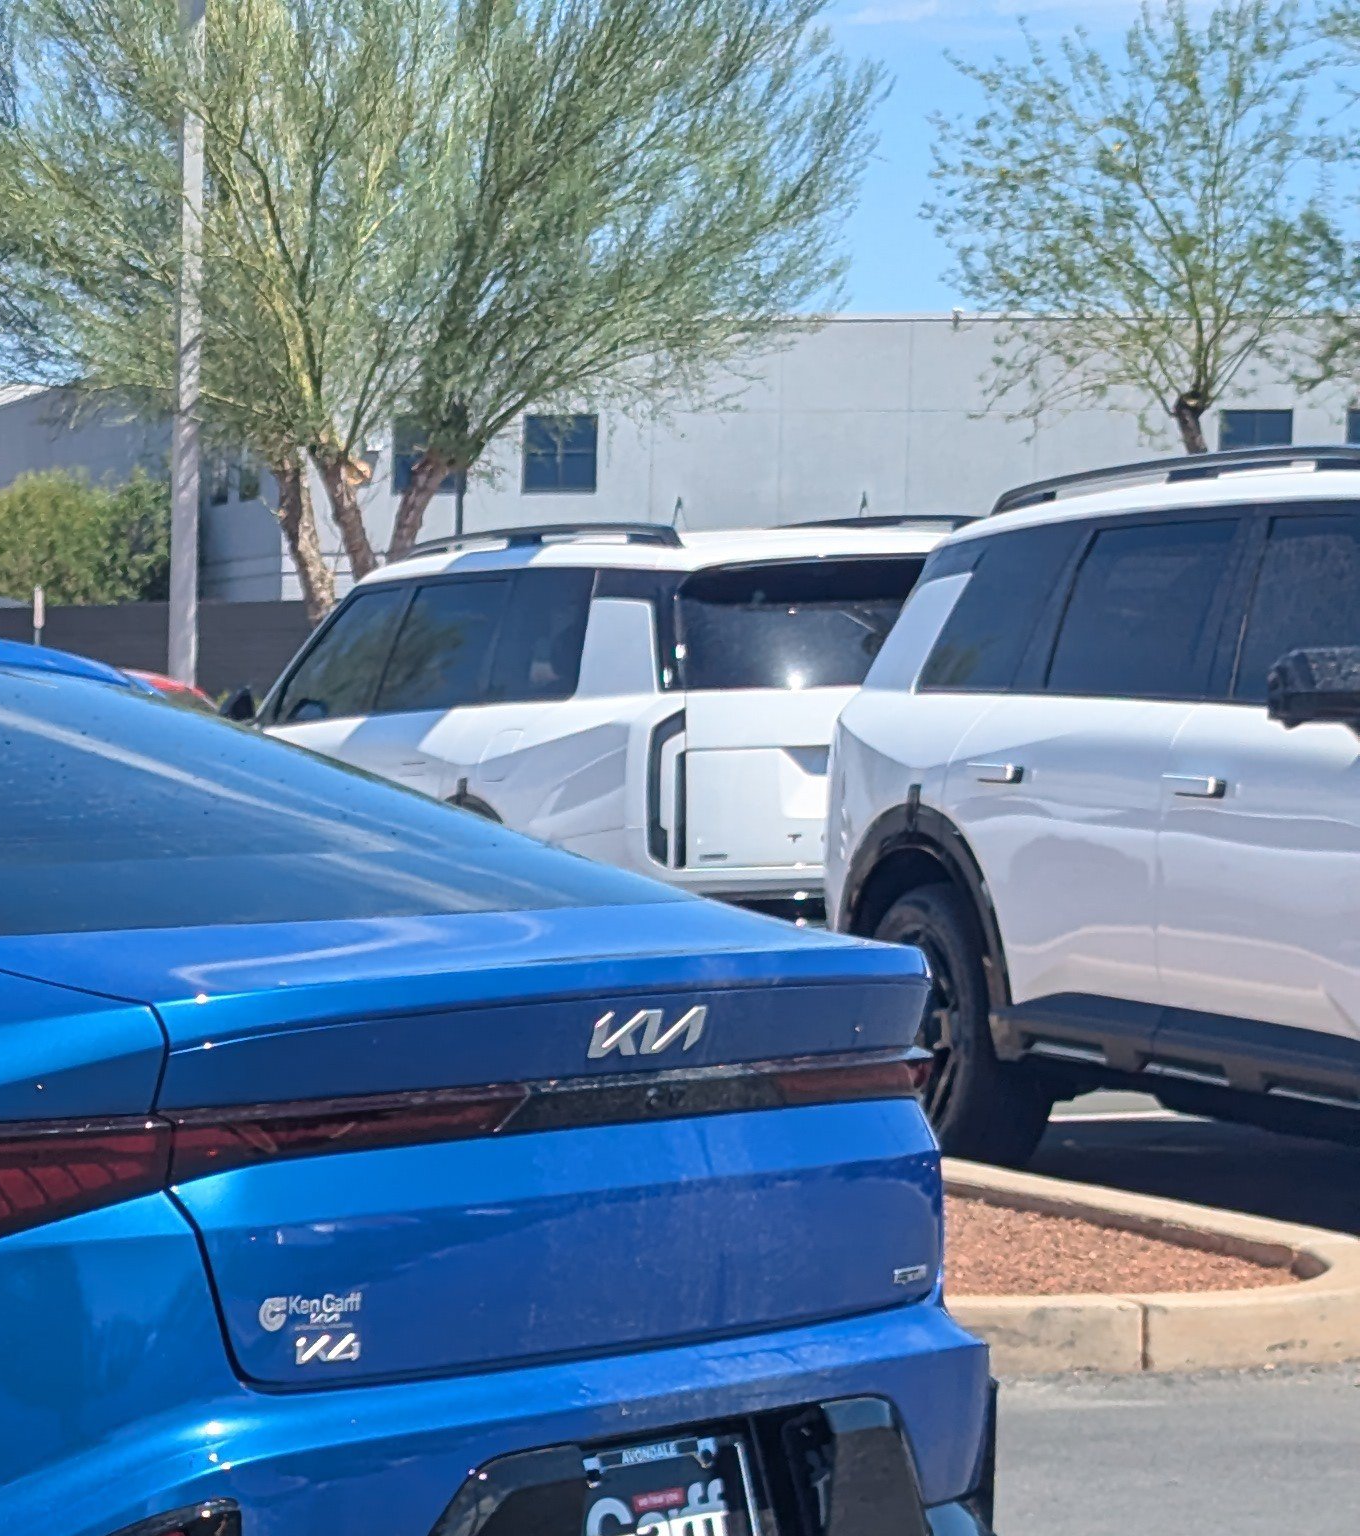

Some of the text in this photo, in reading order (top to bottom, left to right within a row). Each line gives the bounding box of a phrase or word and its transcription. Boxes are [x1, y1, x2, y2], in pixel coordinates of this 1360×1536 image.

[587, 1004, 708, 1059] KIA
[288, 1291, 362, 1315] Ken Garff
[294, 1333, 362, 1365] K4
[622, 1441, 678, 1464] AVONDALE
